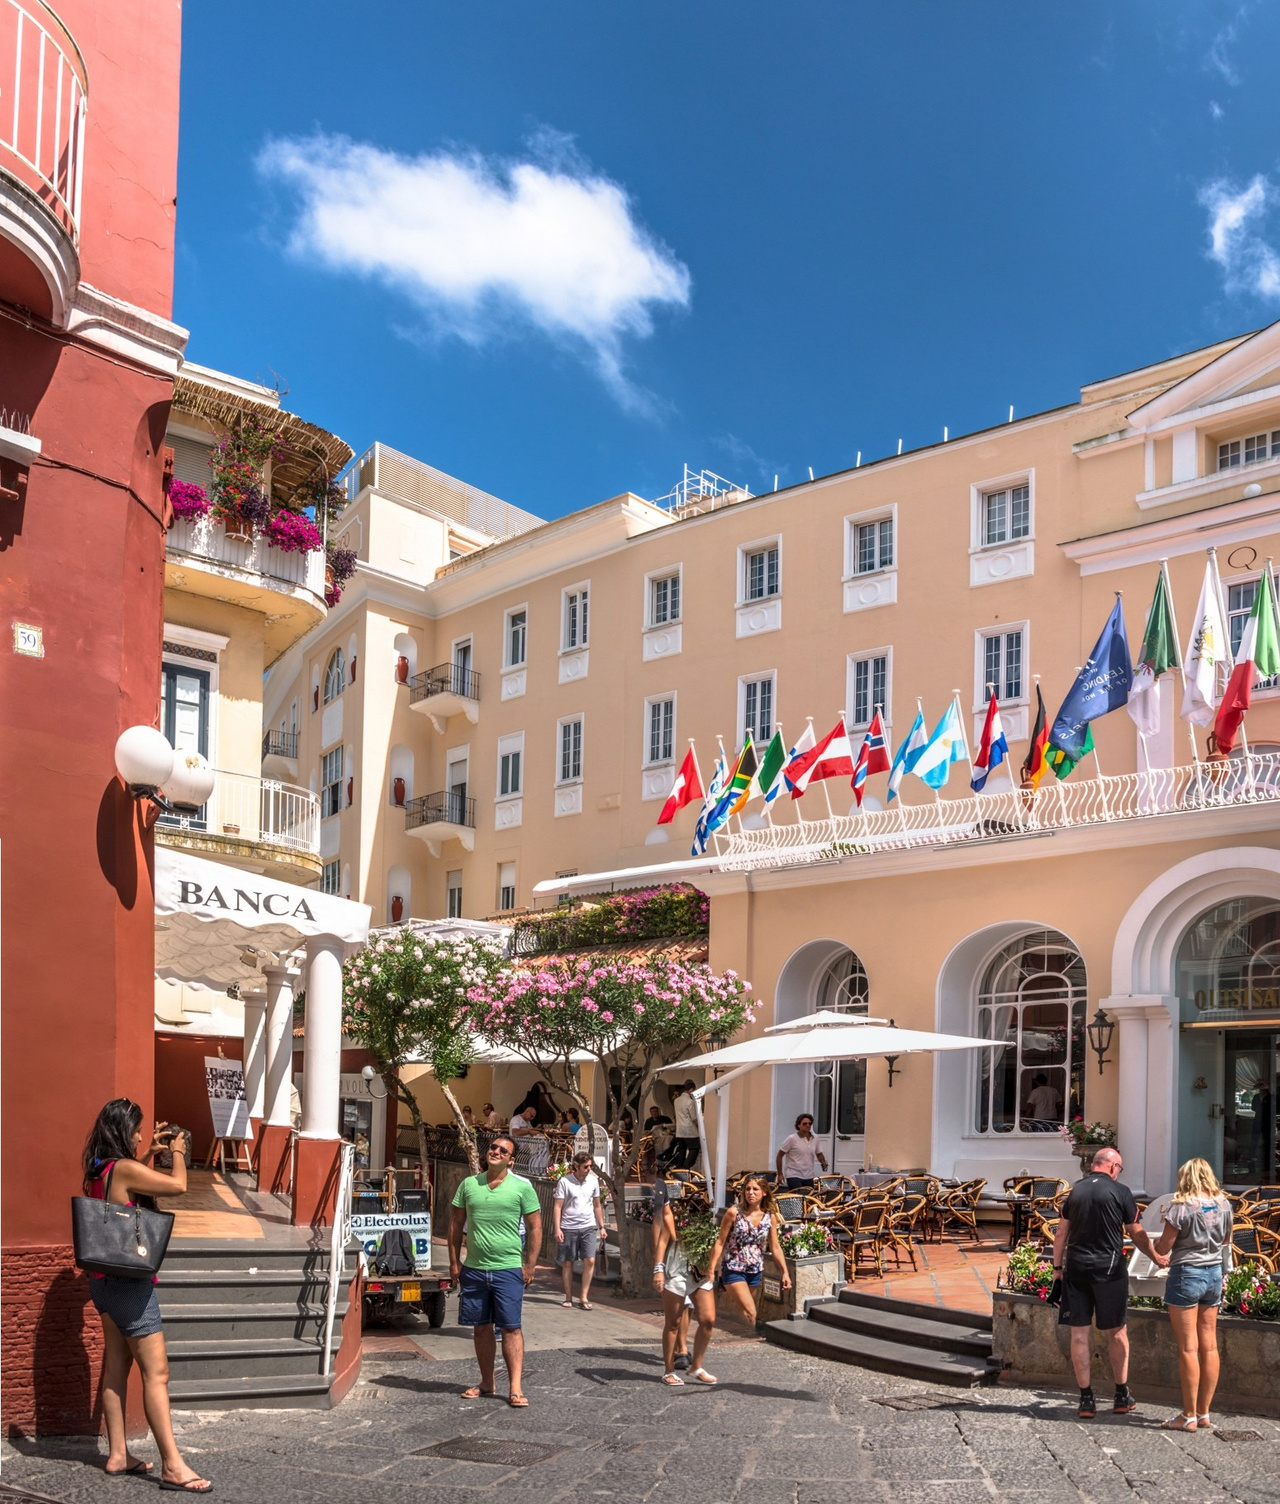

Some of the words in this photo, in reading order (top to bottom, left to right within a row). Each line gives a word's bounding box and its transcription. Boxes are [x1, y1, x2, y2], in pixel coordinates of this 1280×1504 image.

[20, 631, 36, 648] 59
[177, 879, 317, 922] BANCA
[364, 1214, 429, 1227] Electrolux
